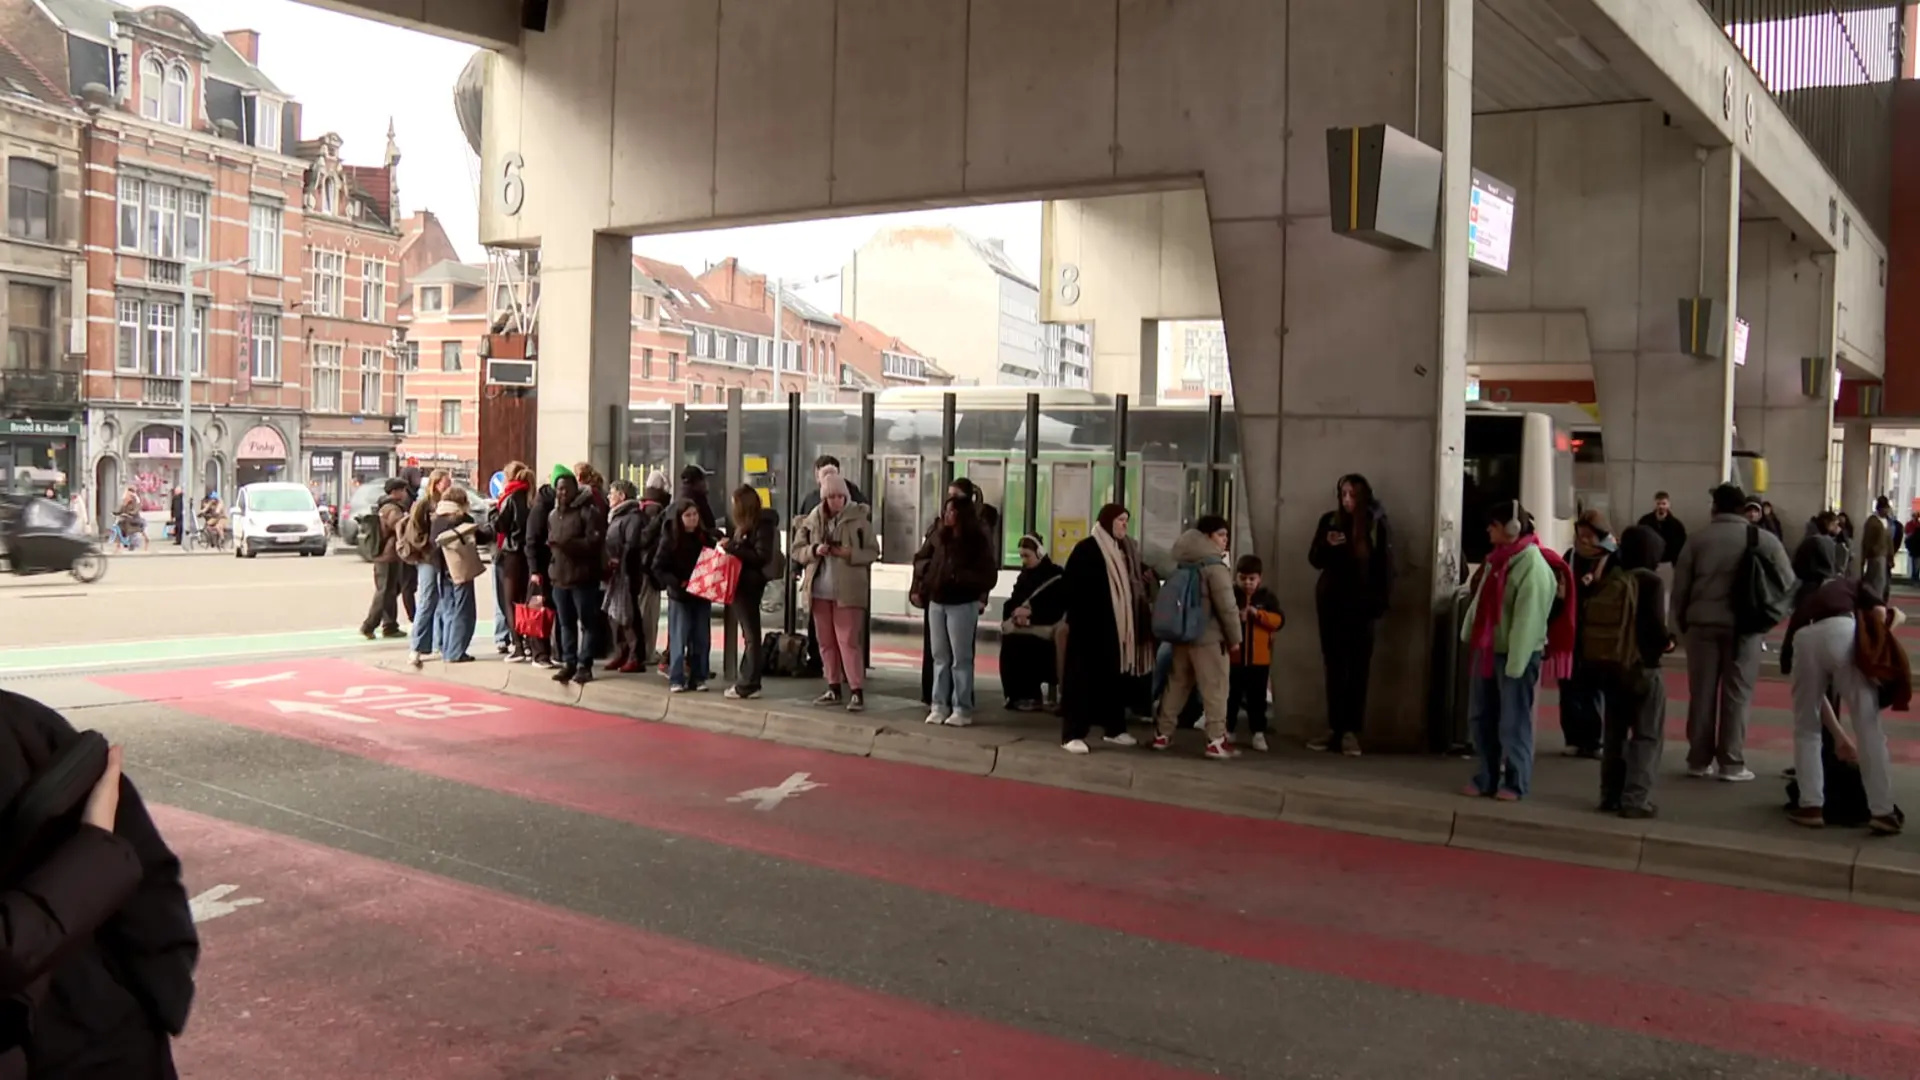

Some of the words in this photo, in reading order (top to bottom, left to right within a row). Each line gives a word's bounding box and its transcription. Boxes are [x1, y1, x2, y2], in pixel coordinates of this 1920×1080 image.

[1723, 65, 1733, 121] 8
[1745, 92, 1754, 144] 9
[499, 151, 525, 216] 6
[1058, 263, 1081, 306] 8
[35, 424, 42, 432] &
[250, 441, 275, 454] Pinky
[312, 456, 334, 466] BLACK
[304, 685, 512, 719] BUS
